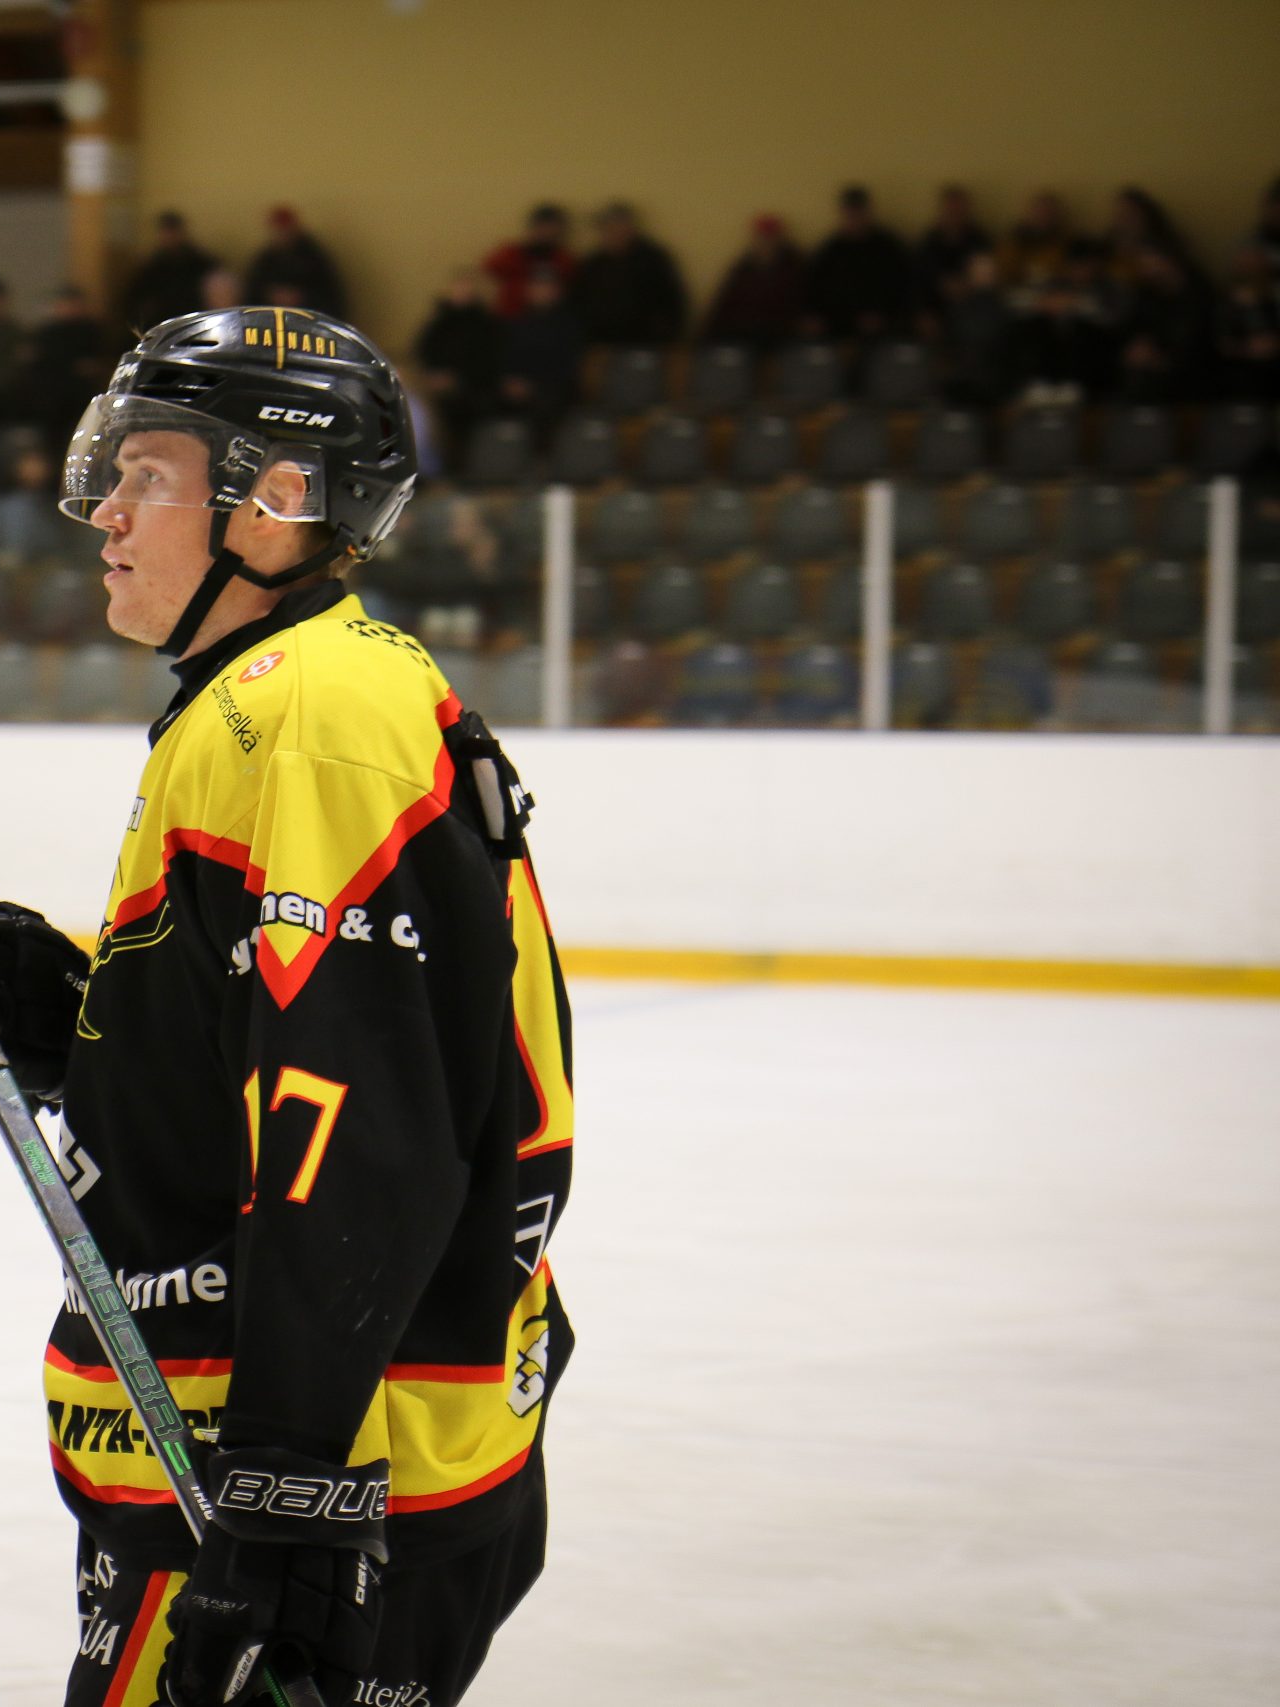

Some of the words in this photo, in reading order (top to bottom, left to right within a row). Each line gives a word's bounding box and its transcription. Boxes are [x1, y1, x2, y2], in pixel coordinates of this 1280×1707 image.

[258, 406, 335, 428] CCM
[338, 906, 374, 942] &
[63, 1233, 185, 1437] RIBCOR
